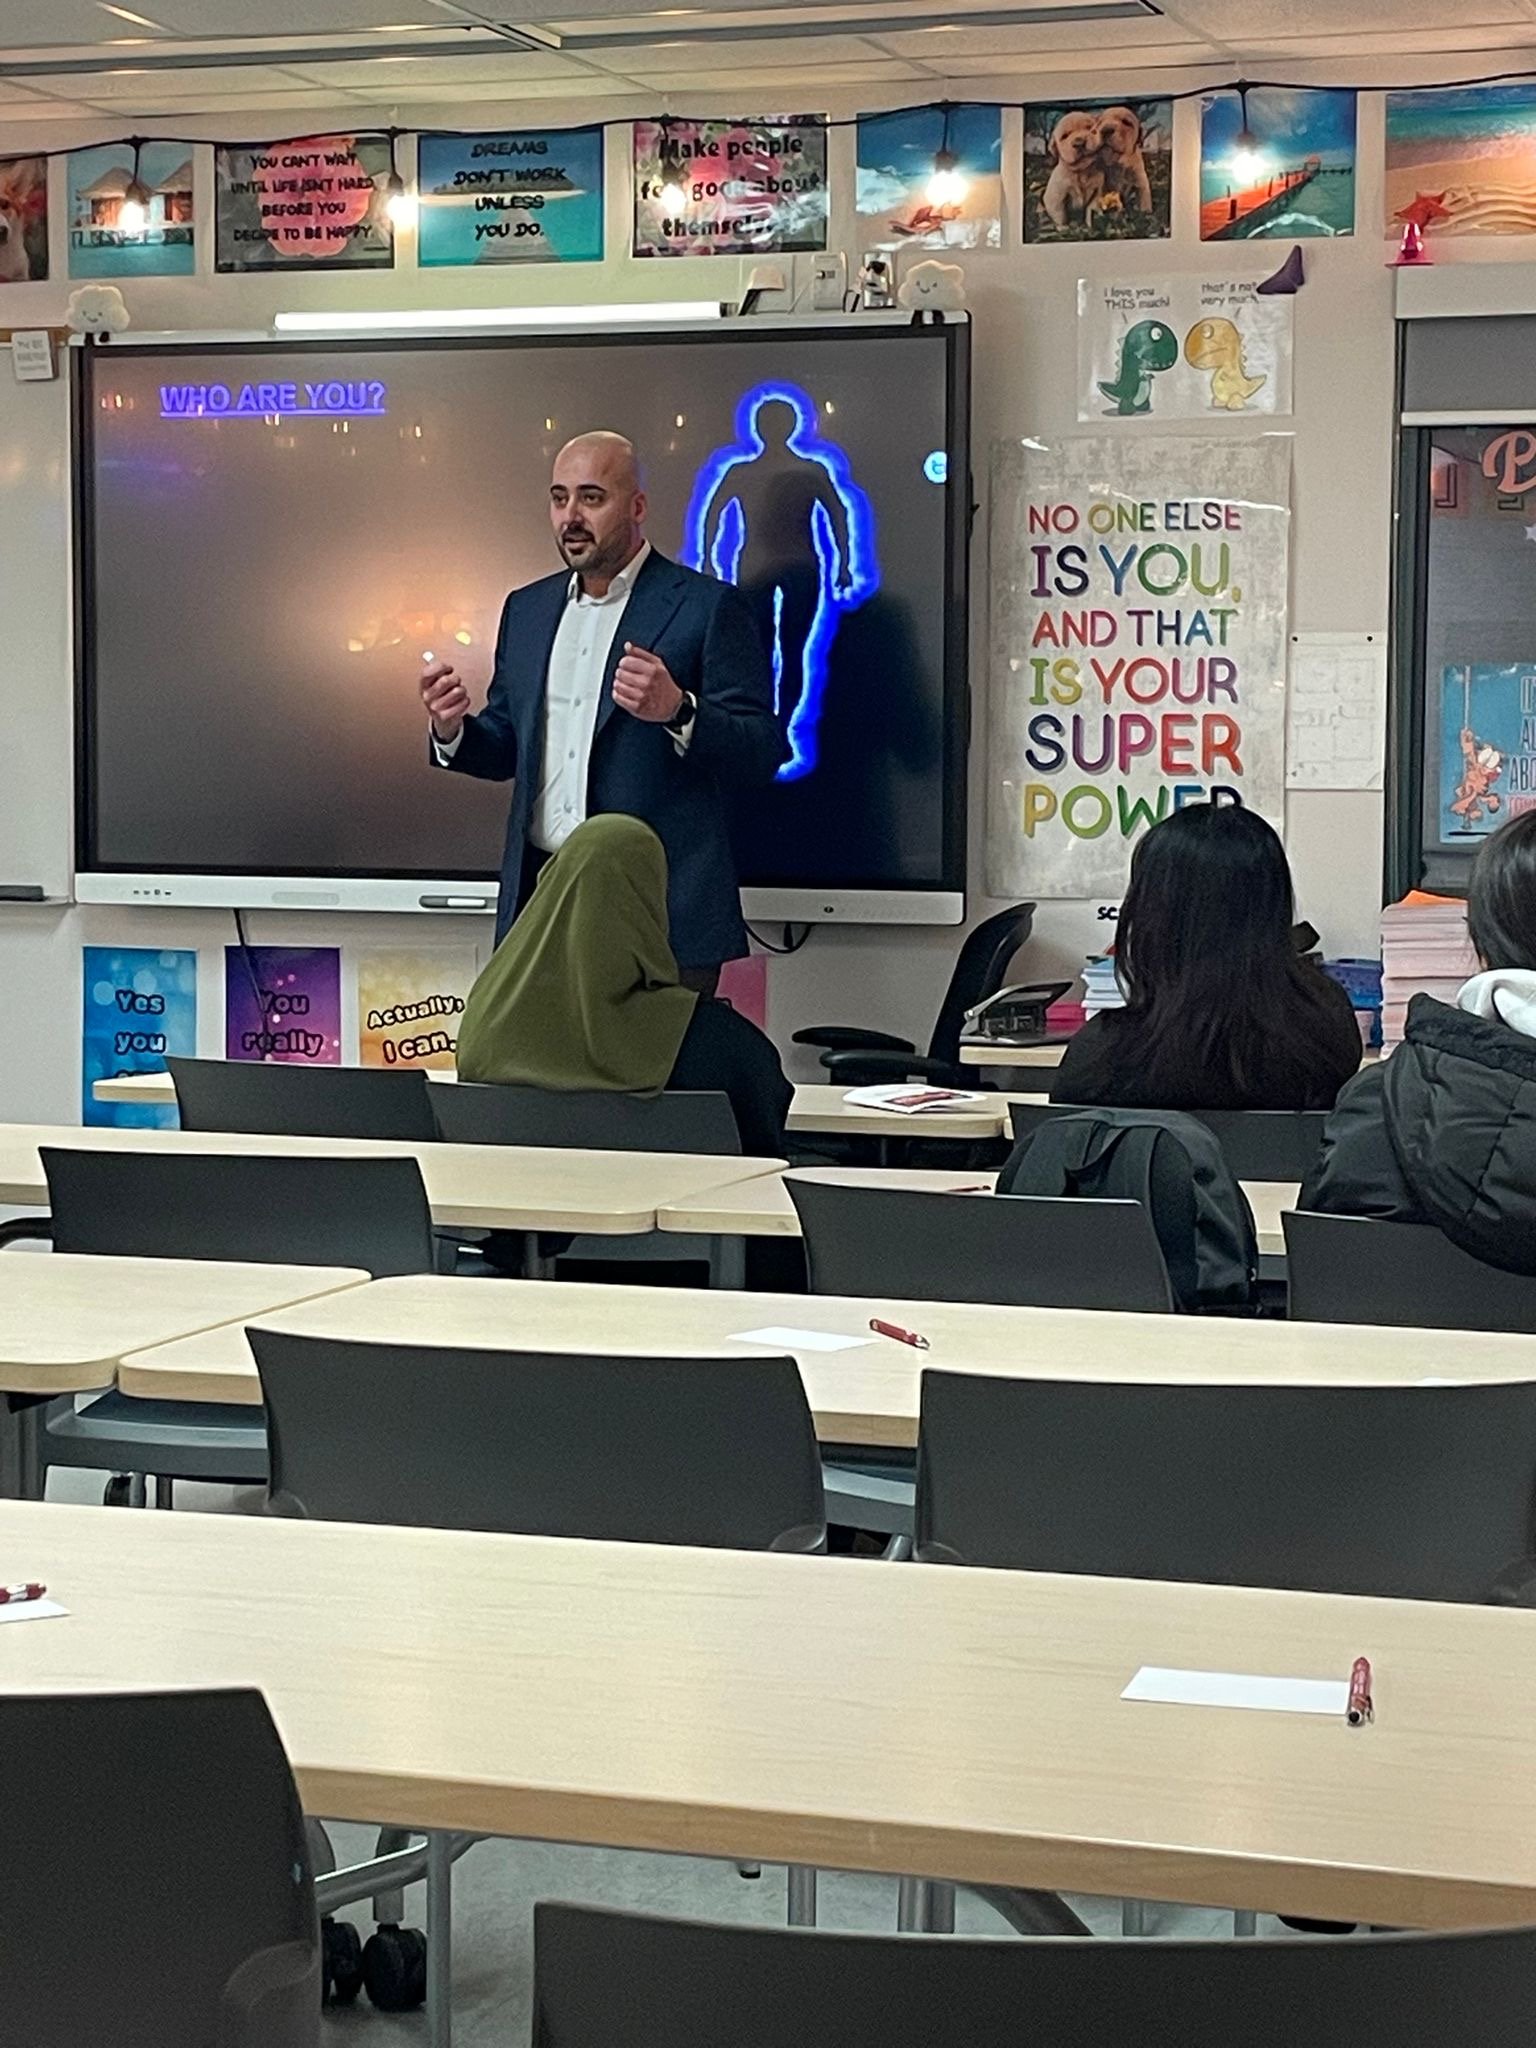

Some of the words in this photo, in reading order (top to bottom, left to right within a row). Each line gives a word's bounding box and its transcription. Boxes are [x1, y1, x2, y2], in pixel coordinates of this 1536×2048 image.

[471, 141, 549, 158] DREAMS
[659, 138, 719, 159] Make
[728, 134, 803, 160] people
[250, 155, 278, 170] YOU
[323, 152, 358, 166] WAIT
[231, 182, 268, 194] UNTIL
[272, 180, 297, 193] LIFE
[338, 177, 375, 190] HARD
[453, 168, 511, 185] DON'T
[515, 167, 567, 181] WORK
[262, 203, 313, 217] BEFORE
[317, 202, 346, 215] YOU
[475, 195, 545, 211] UNLESS
[233, 228, 279, 241] DECIDE
[283, 228, 300, 240] TO
[304, 226, 322, 239] BE
[475, 223, 510, 241] YOU
[514, 223, 545, 237] DO.
[1111, 286, 1132, 297] love
[1135, 288, 1154, 299] you
[1201, 282, 1235, 293] that's
[1104, 299, 1134, 310] THIS
[1201, 297, 1225, 306] very
[160, 385, 231, 412] WHO
[236, 384, 296, 411] ARE
[304, 382, 386, 409] YOU?
[1029, 505, 1080, 533] NO
[1088, 503, 1156, 533] ONE
[1164, 502, 1242, 531] ELSE
[1030, 545, 1090, 597] IS
[1099, 543, 1242, 603] YOU.
[1032, 610, 1118, 648] AND
[1127, 608, 1239, 646] THAT
[1030, 658, 1083, 705] IS
[1090, 657, 1239, 704] YOUR
[1025, 713, 1244, 776] SUPER
[115, 989, 165, 1015] Yes
[260, 990, 310, 1015] You
[367, 995, 465, 1030] Actually,
[114, 1032, 167, 1056] you
[241, 1029, 324, 1057] really
[382, 1040, 397, 1064] I
[398, 1031, 456, 1060] can.
